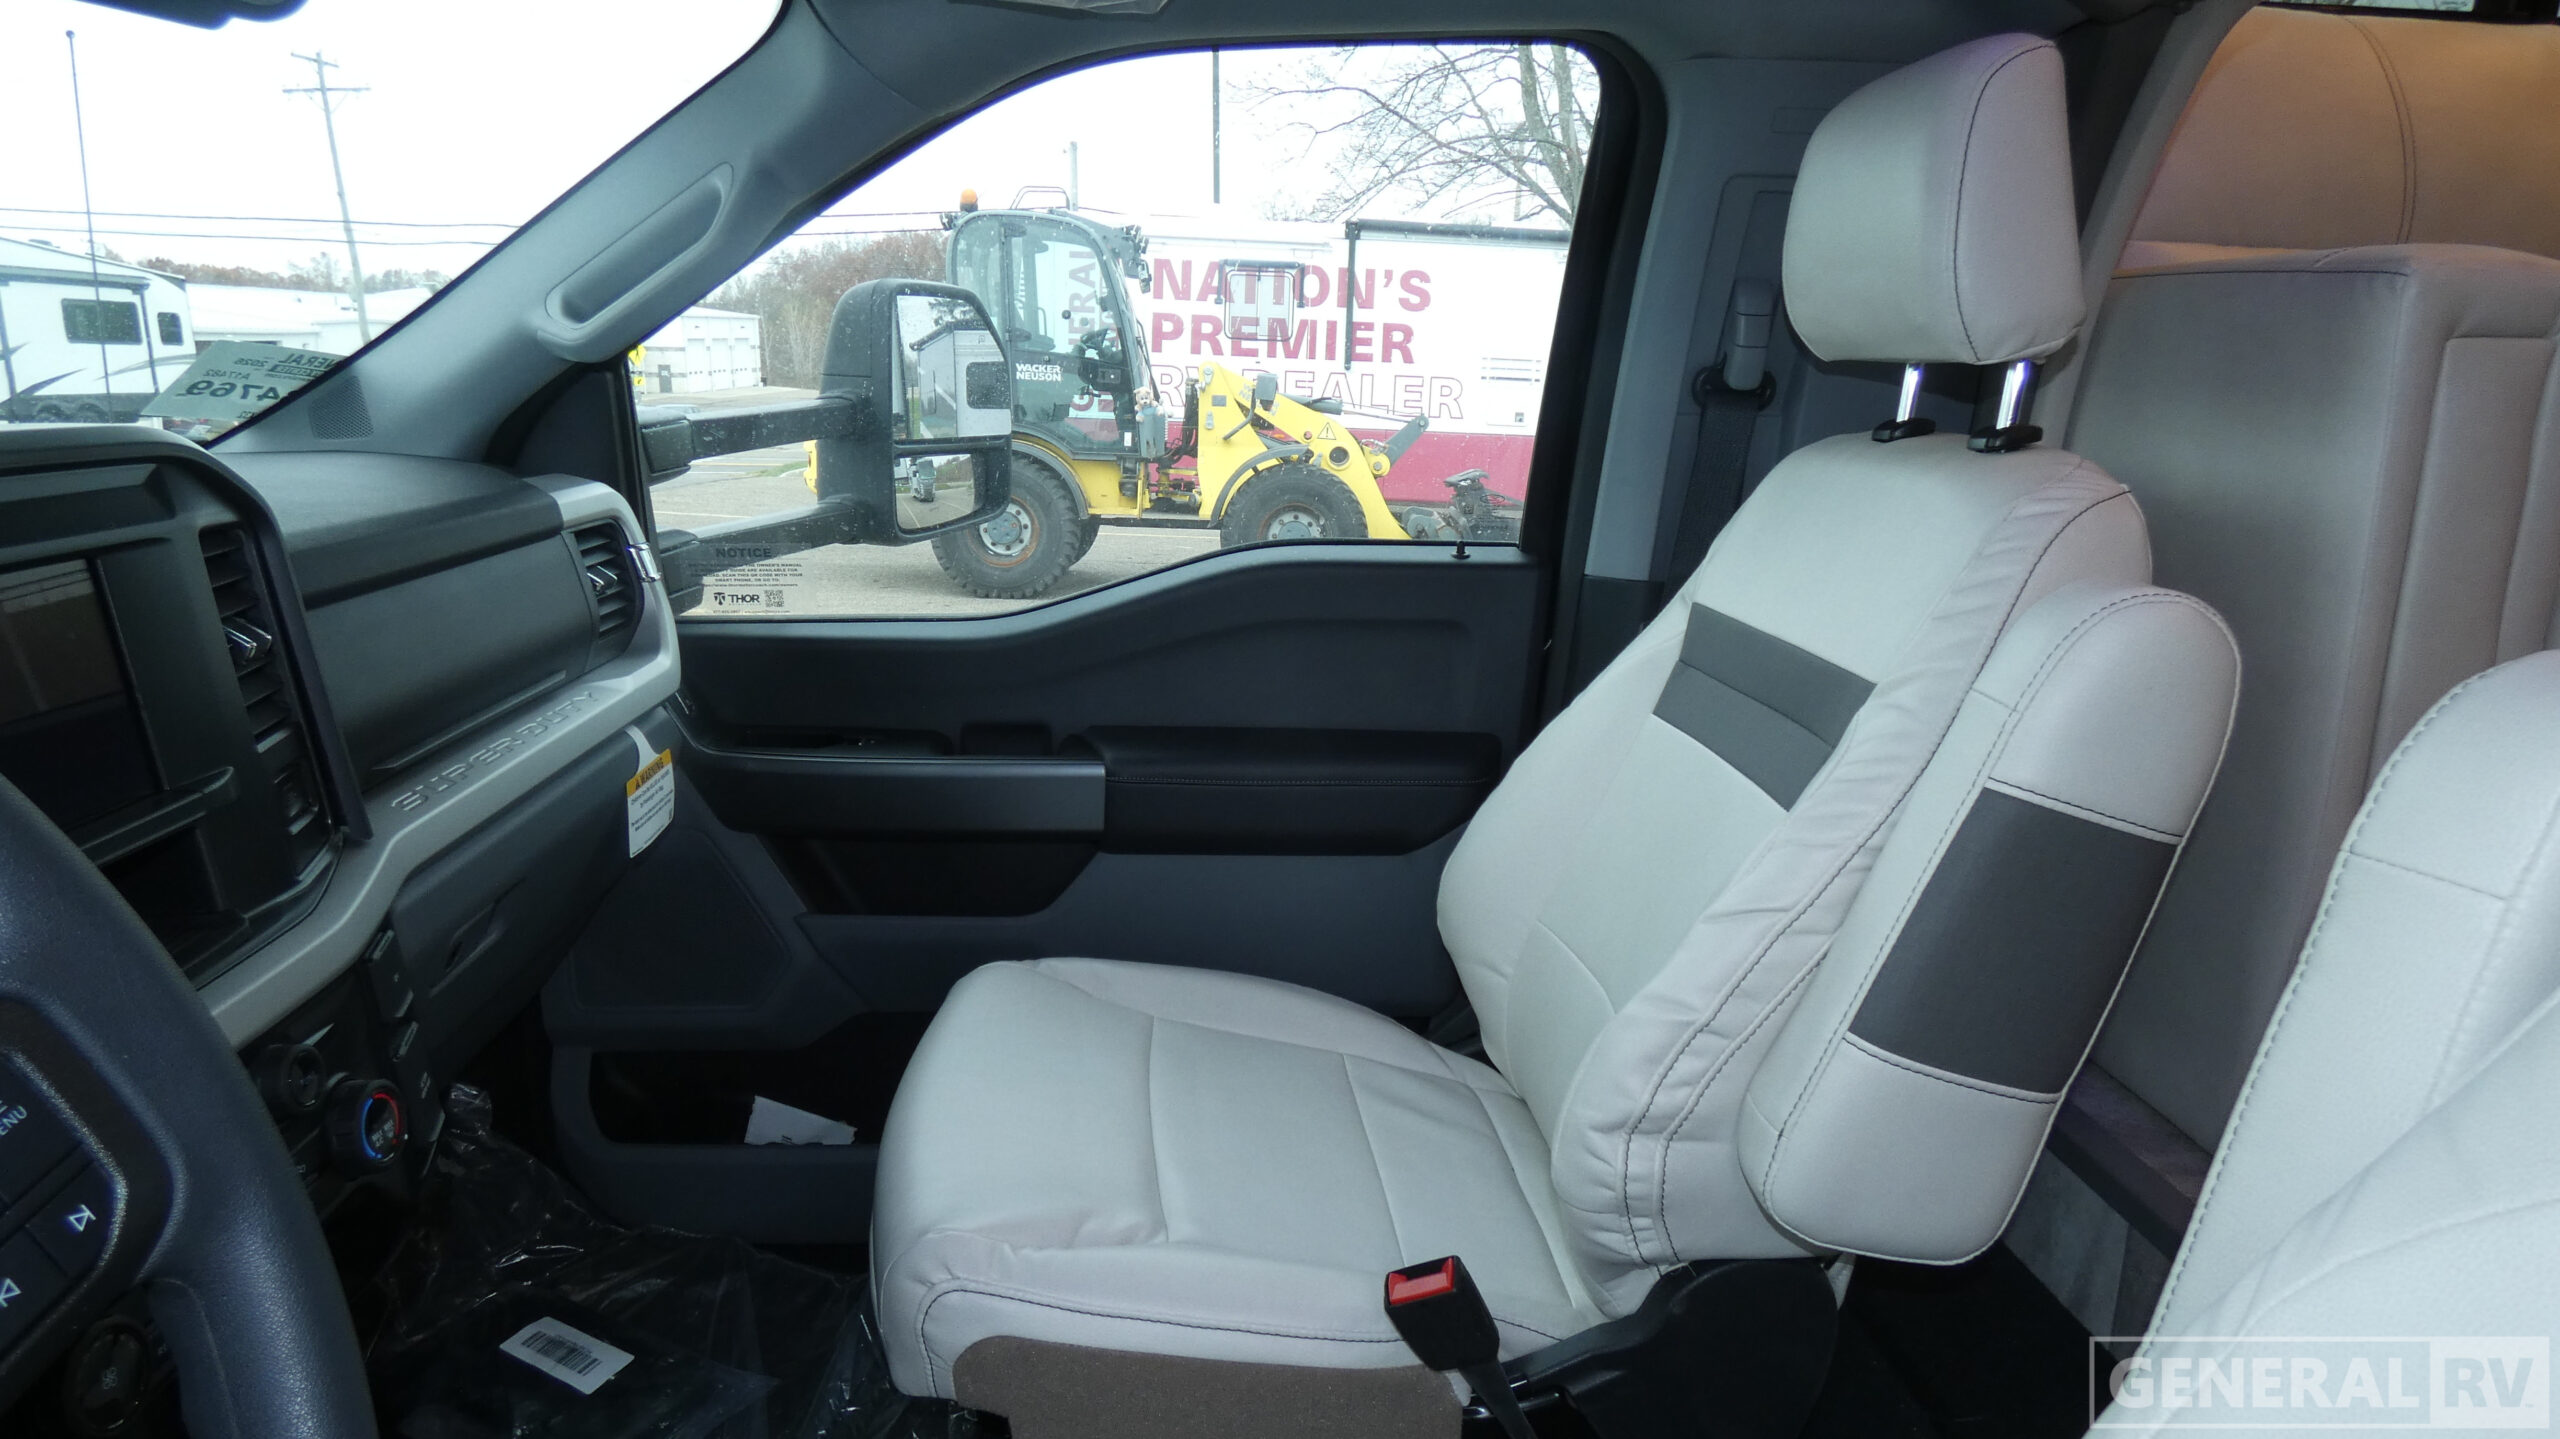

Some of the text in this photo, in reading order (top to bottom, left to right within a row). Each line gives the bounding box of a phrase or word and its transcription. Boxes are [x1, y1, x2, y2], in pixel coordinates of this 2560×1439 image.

[1153, 258, 1432, 312] NATION'S
[1068, 250, 1097, 412] GERAL
[1151, 312, 1415, 364] PREMIER
[1015, 363, 1062, 373] WACKER
[1015, 371, 1062, 382] NEUSON
[1150, 364, 1199, 408] R
[715, 547, 772, 558] NOTICE
[727, 594, 760, 603] THOR
[391, 690, 598, 812] SUPER DUTY
[0, 1105, 28, 1137] ENU
